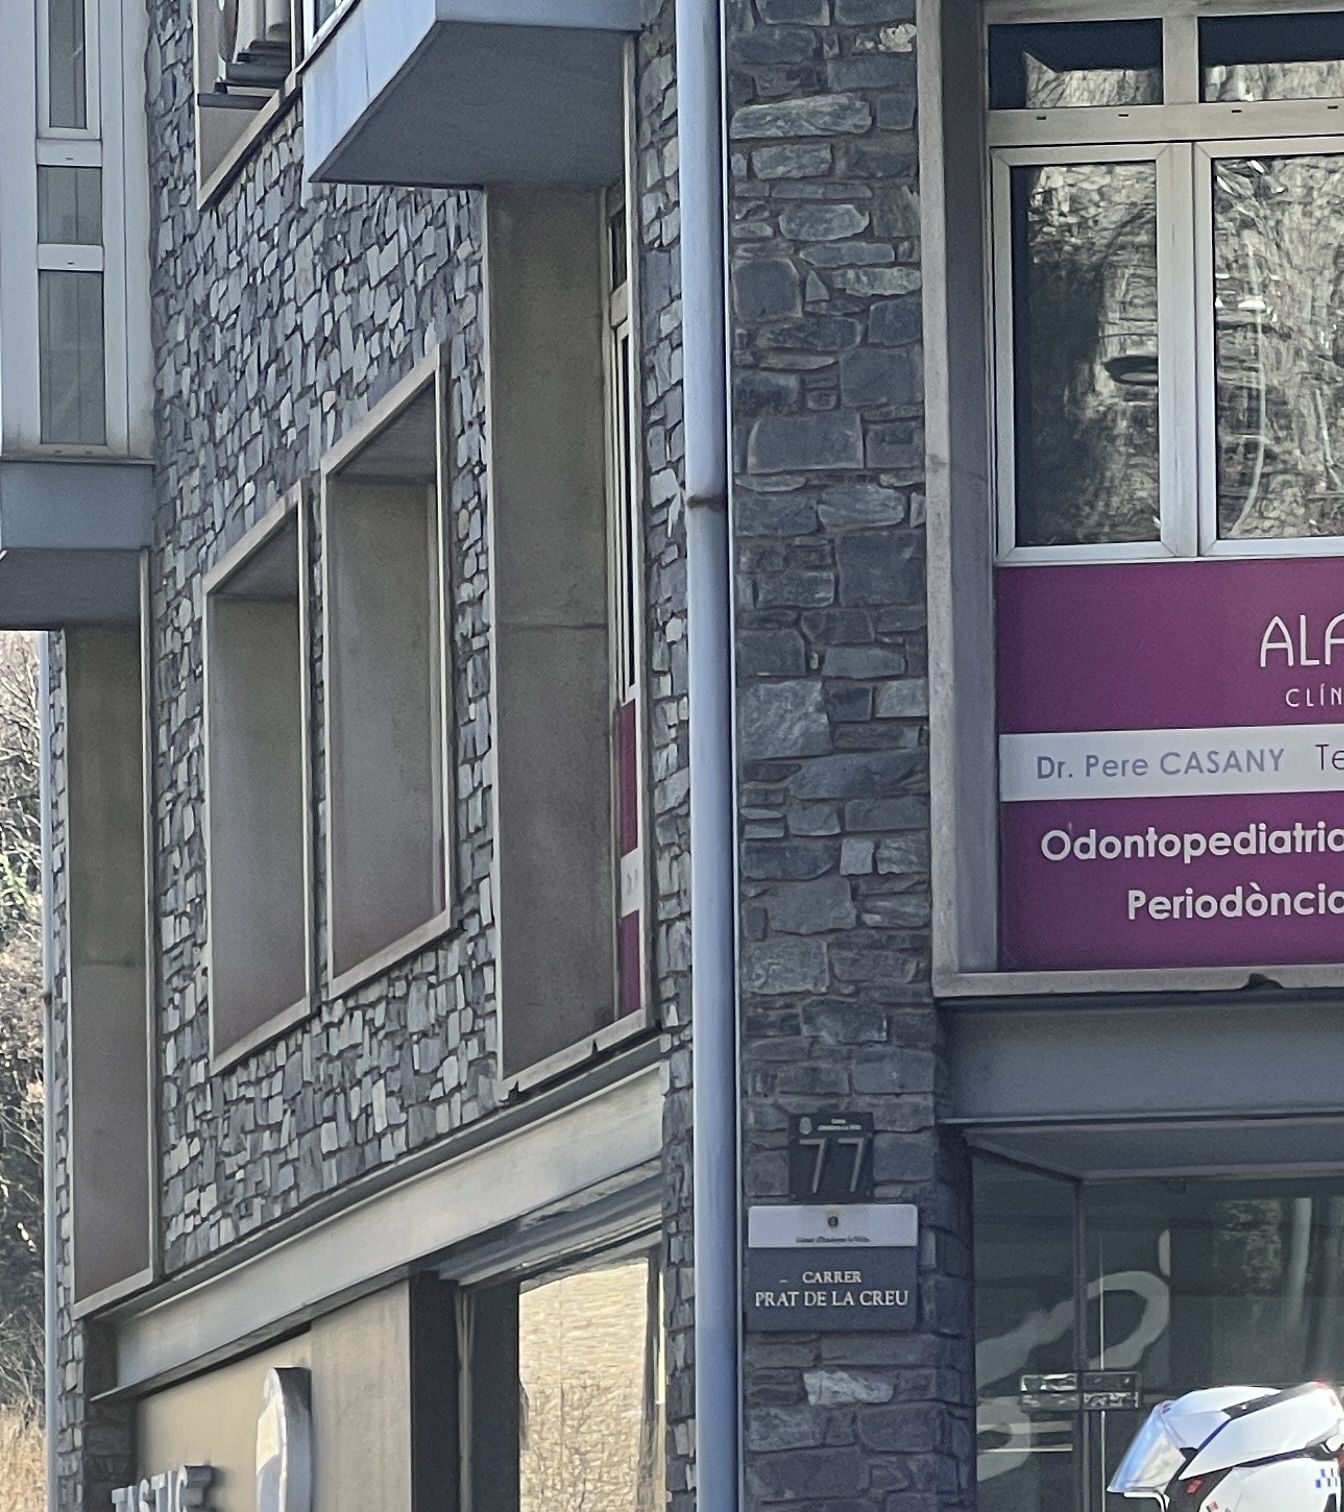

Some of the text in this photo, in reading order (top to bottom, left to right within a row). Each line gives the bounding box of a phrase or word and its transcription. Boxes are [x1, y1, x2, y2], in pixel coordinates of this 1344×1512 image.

[1036, 755, 1074, 780] Dr.
[1085, 754, 1149, 778] Pere
[1159, 748, 1285, 776] CASANY
[799, 1137, 864, 1194] 77
[802, 1271, 863, 1284] CARRER
[755, 1290, 909, 1307] PRAT DE LA CREU
